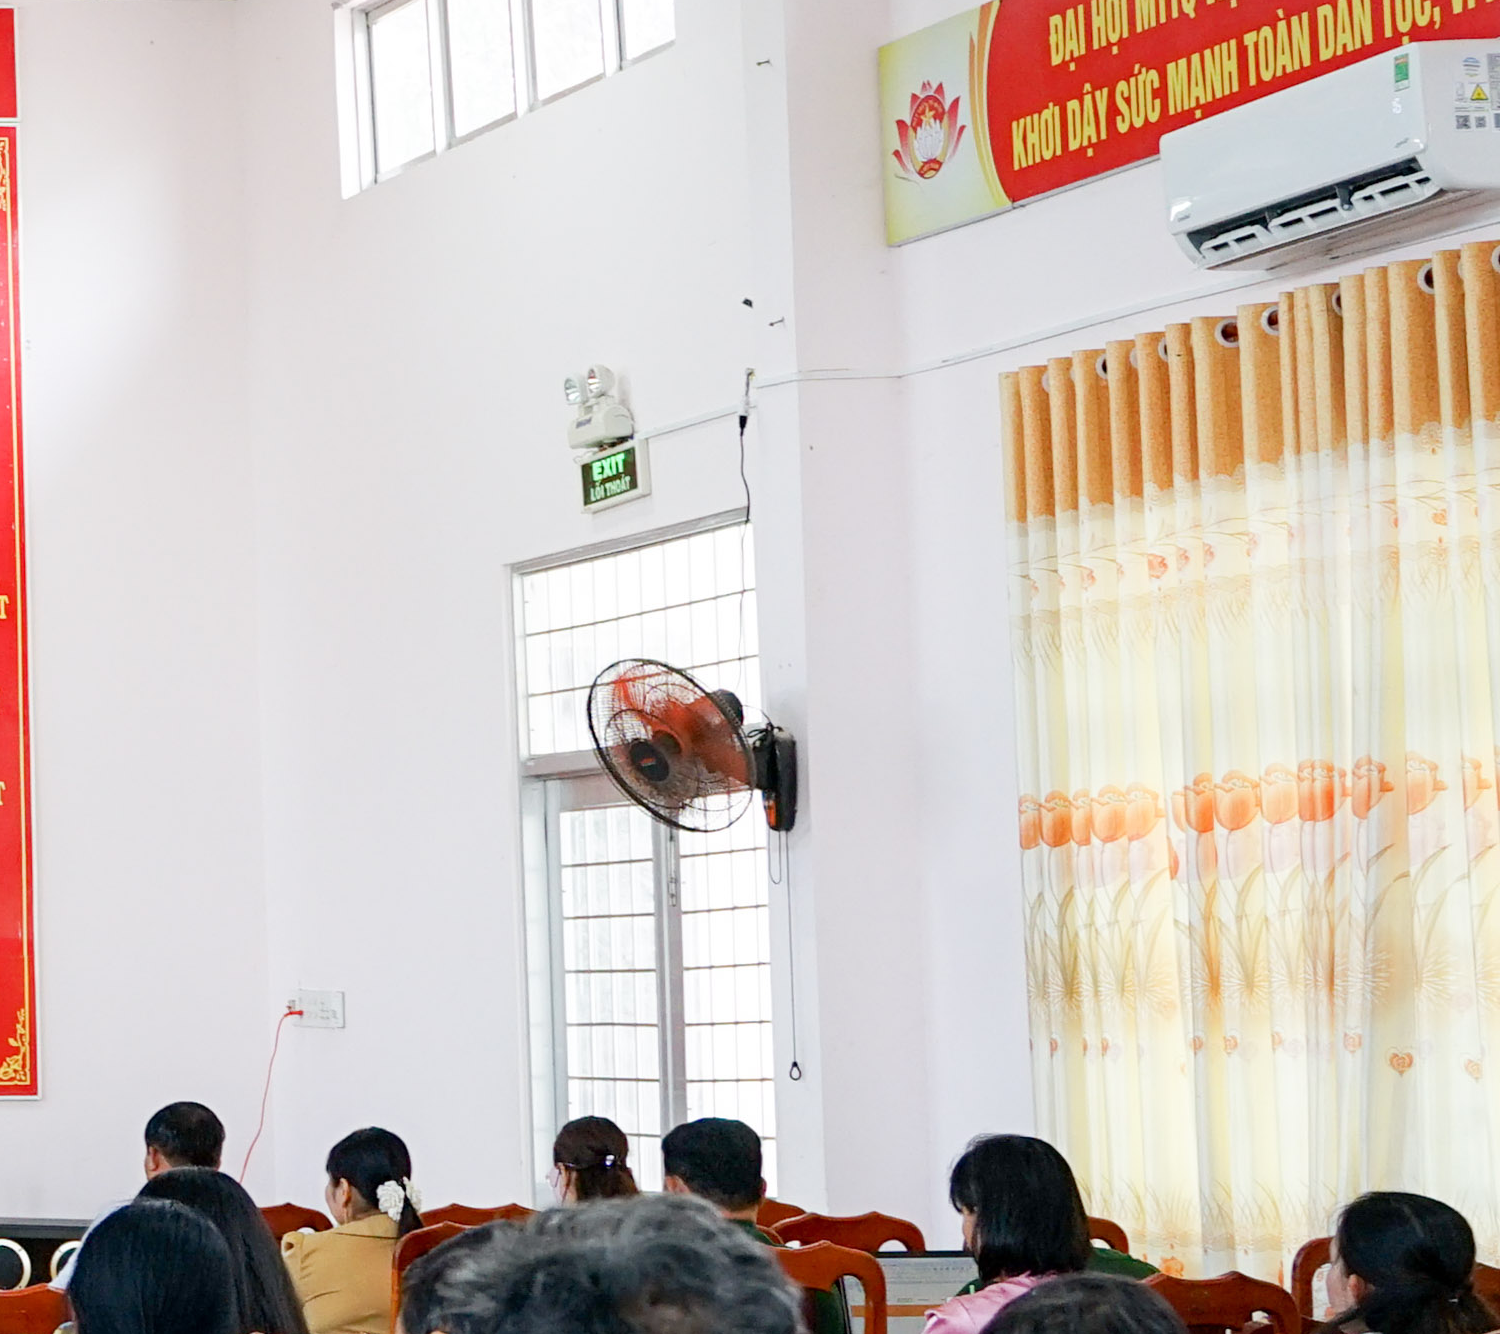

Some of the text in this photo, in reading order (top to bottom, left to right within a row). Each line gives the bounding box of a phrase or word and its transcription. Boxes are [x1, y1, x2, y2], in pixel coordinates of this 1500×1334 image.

[1049, 4, 1085, 71] ĐẠI
[1012, 102, 1061, 170] KHƠI
[1067, 83, 1108, 156] DẬY
[1116, 64, 1160, 133] SỨC
[1167, 44, 1239, 118] MẠNH
[1244, 13, 1312, 85] TOÀN
[592, 453, 626, 481] EXIT
